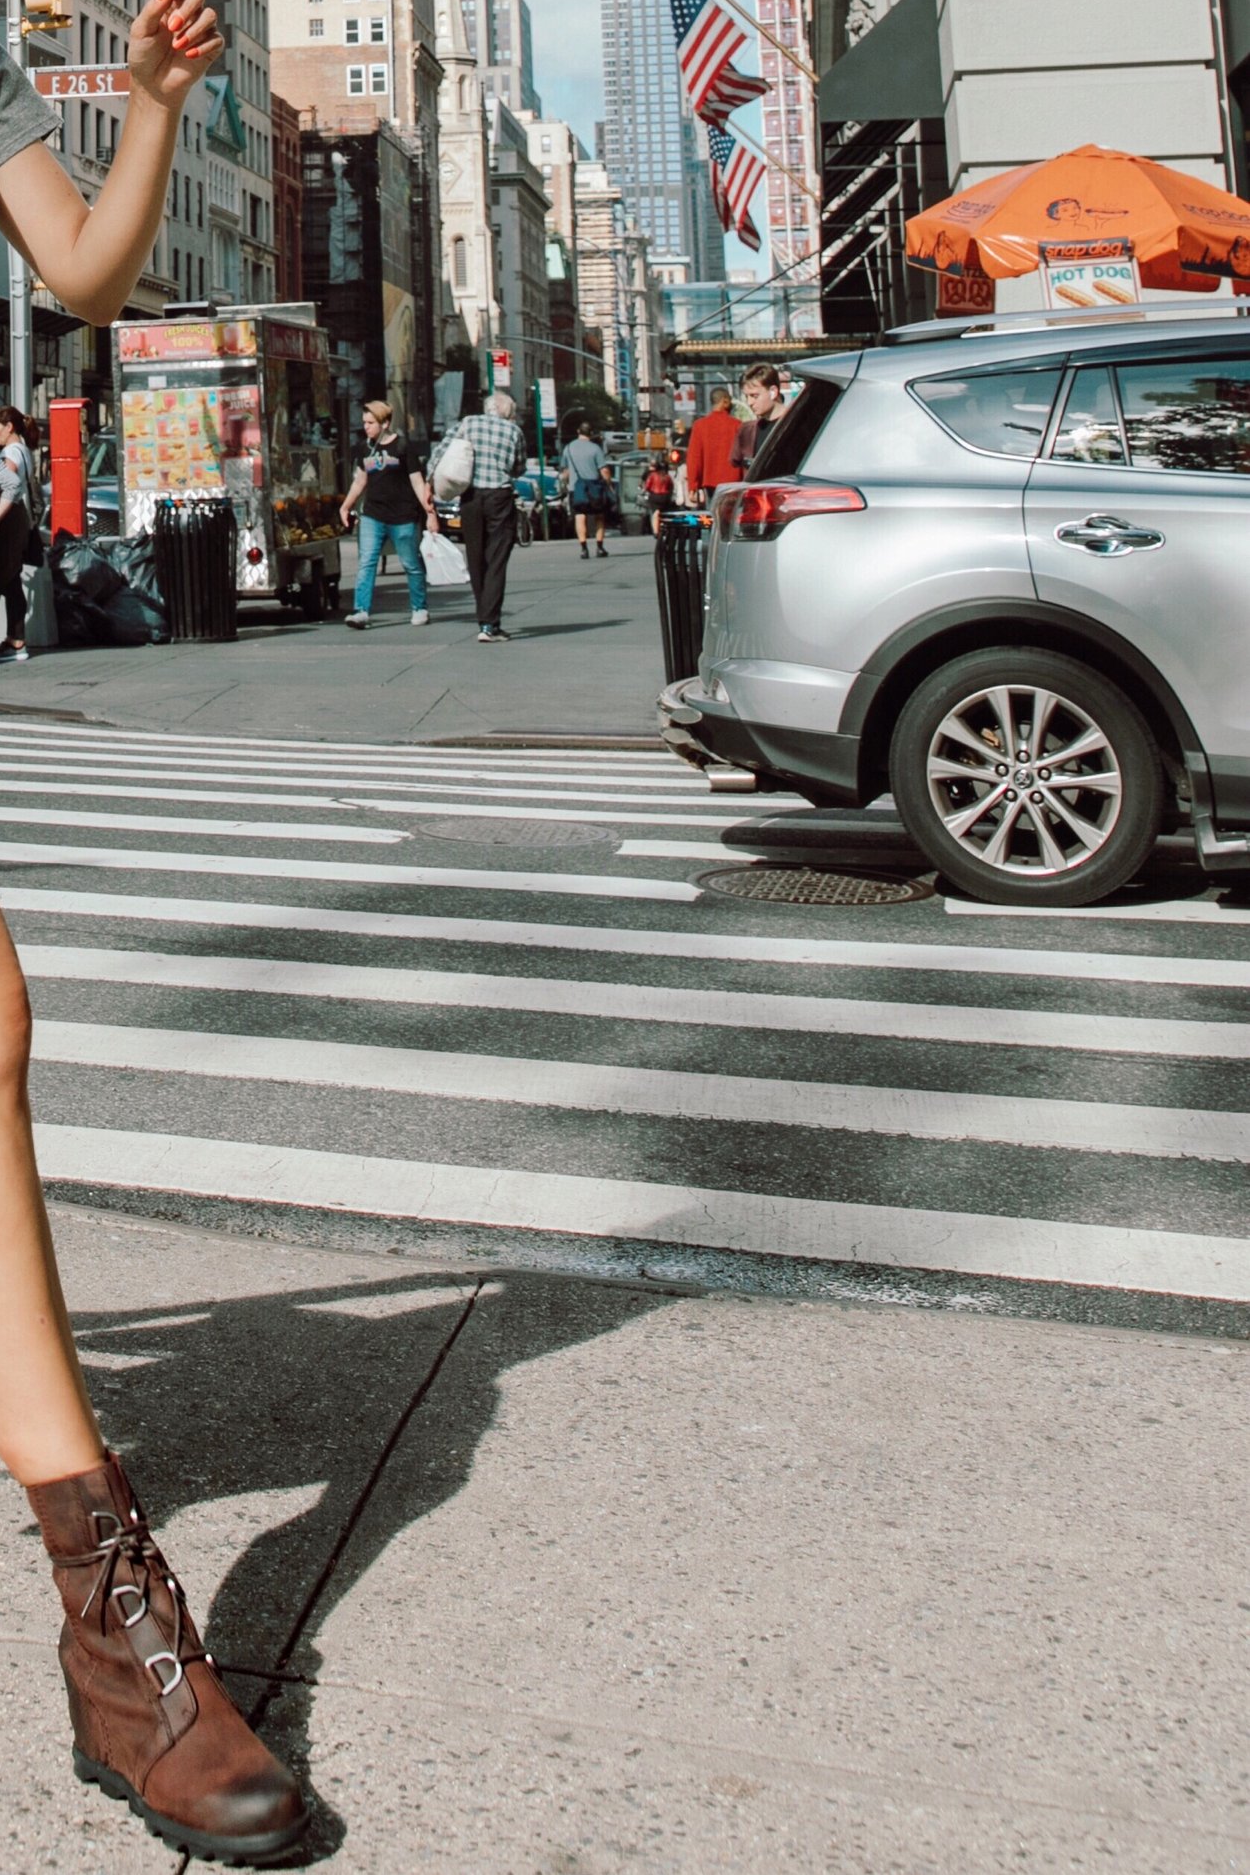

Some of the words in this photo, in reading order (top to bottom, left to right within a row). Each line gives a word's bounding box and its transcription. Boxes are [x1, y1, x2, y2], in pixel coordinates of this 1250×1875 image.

[51, 76, 60, 95] E
[68, 74, 88, 94] 26
[96, 73, 114, 93] St
[1045, 244, 1087, 260] snap
[1089, 240, 1124, 258] dog
[1051, 267, 1085, 285] HOT
[1093, 266, 1132, 280] DOG
[172, 337, 204, 348] 100%
[229, 398, 256, 410] JUICE
